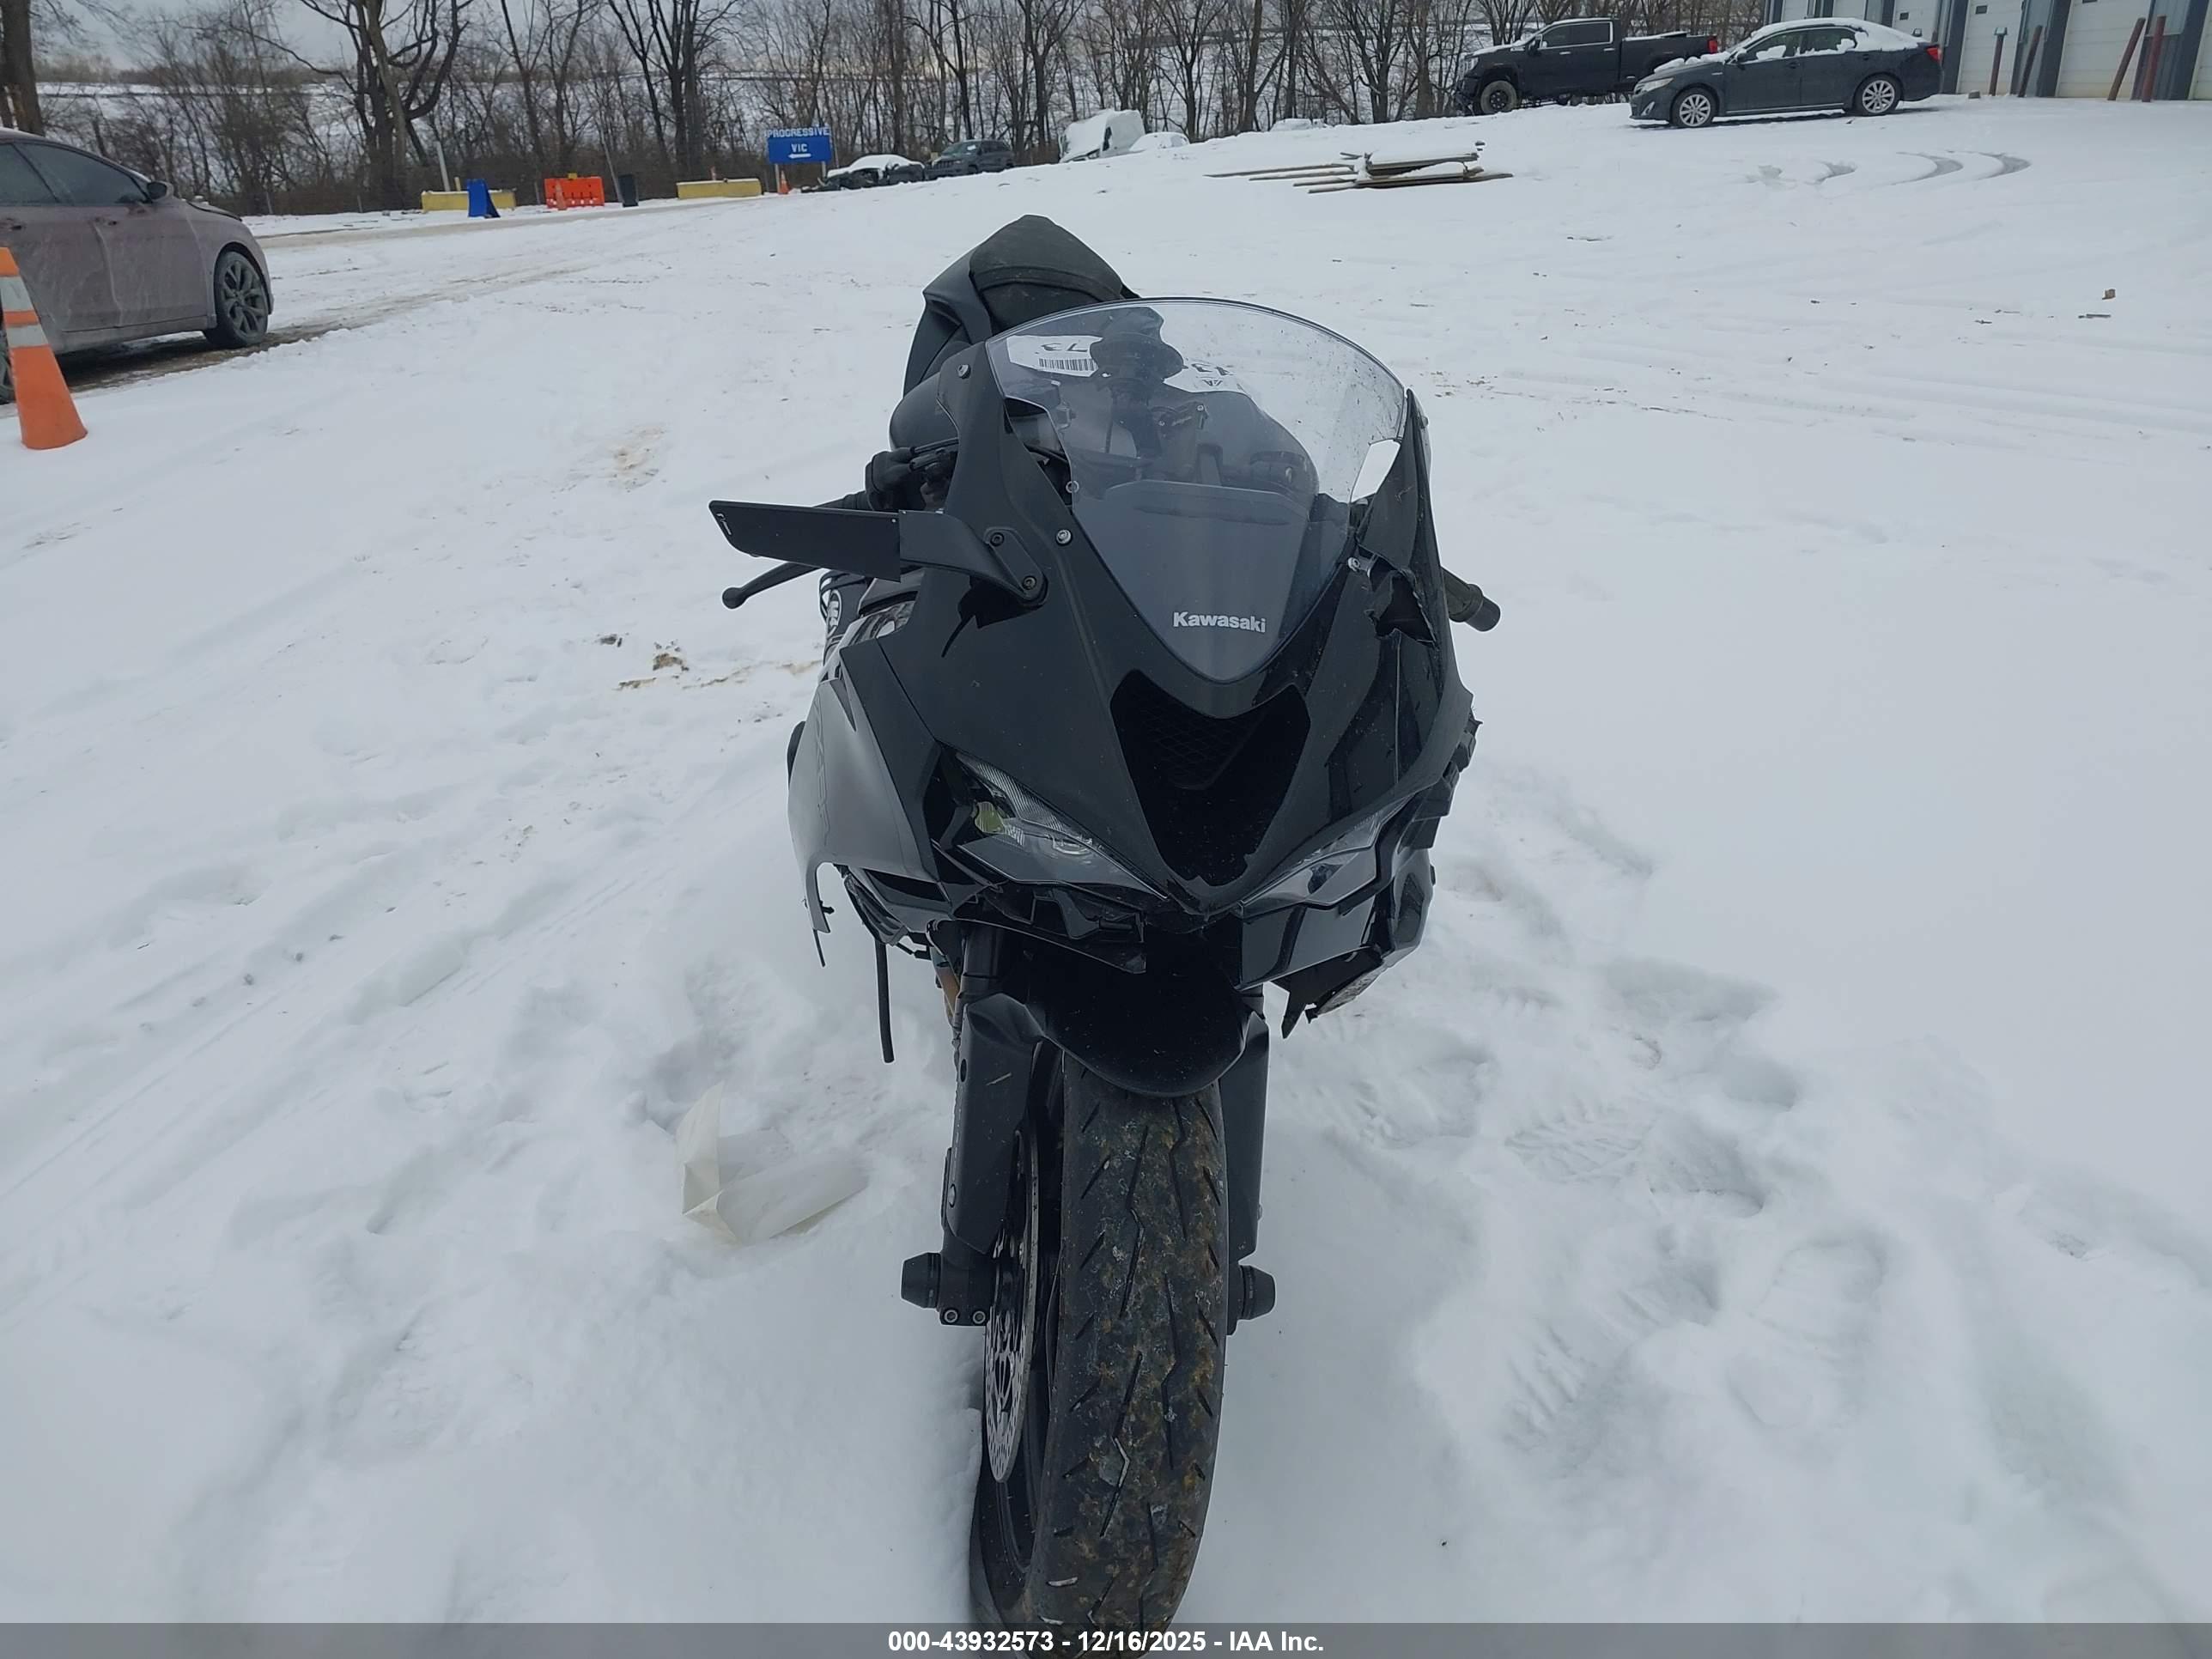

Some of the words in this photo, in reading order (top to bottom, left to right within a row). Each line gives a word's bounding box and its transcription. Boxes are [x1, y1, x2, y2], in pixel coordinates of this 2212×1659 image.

[768, 126, 830, 138] PROGRESSIVE
[791, 143, 808, 153] VIC
[1173, 611, 1267, 634] Kawasaki
